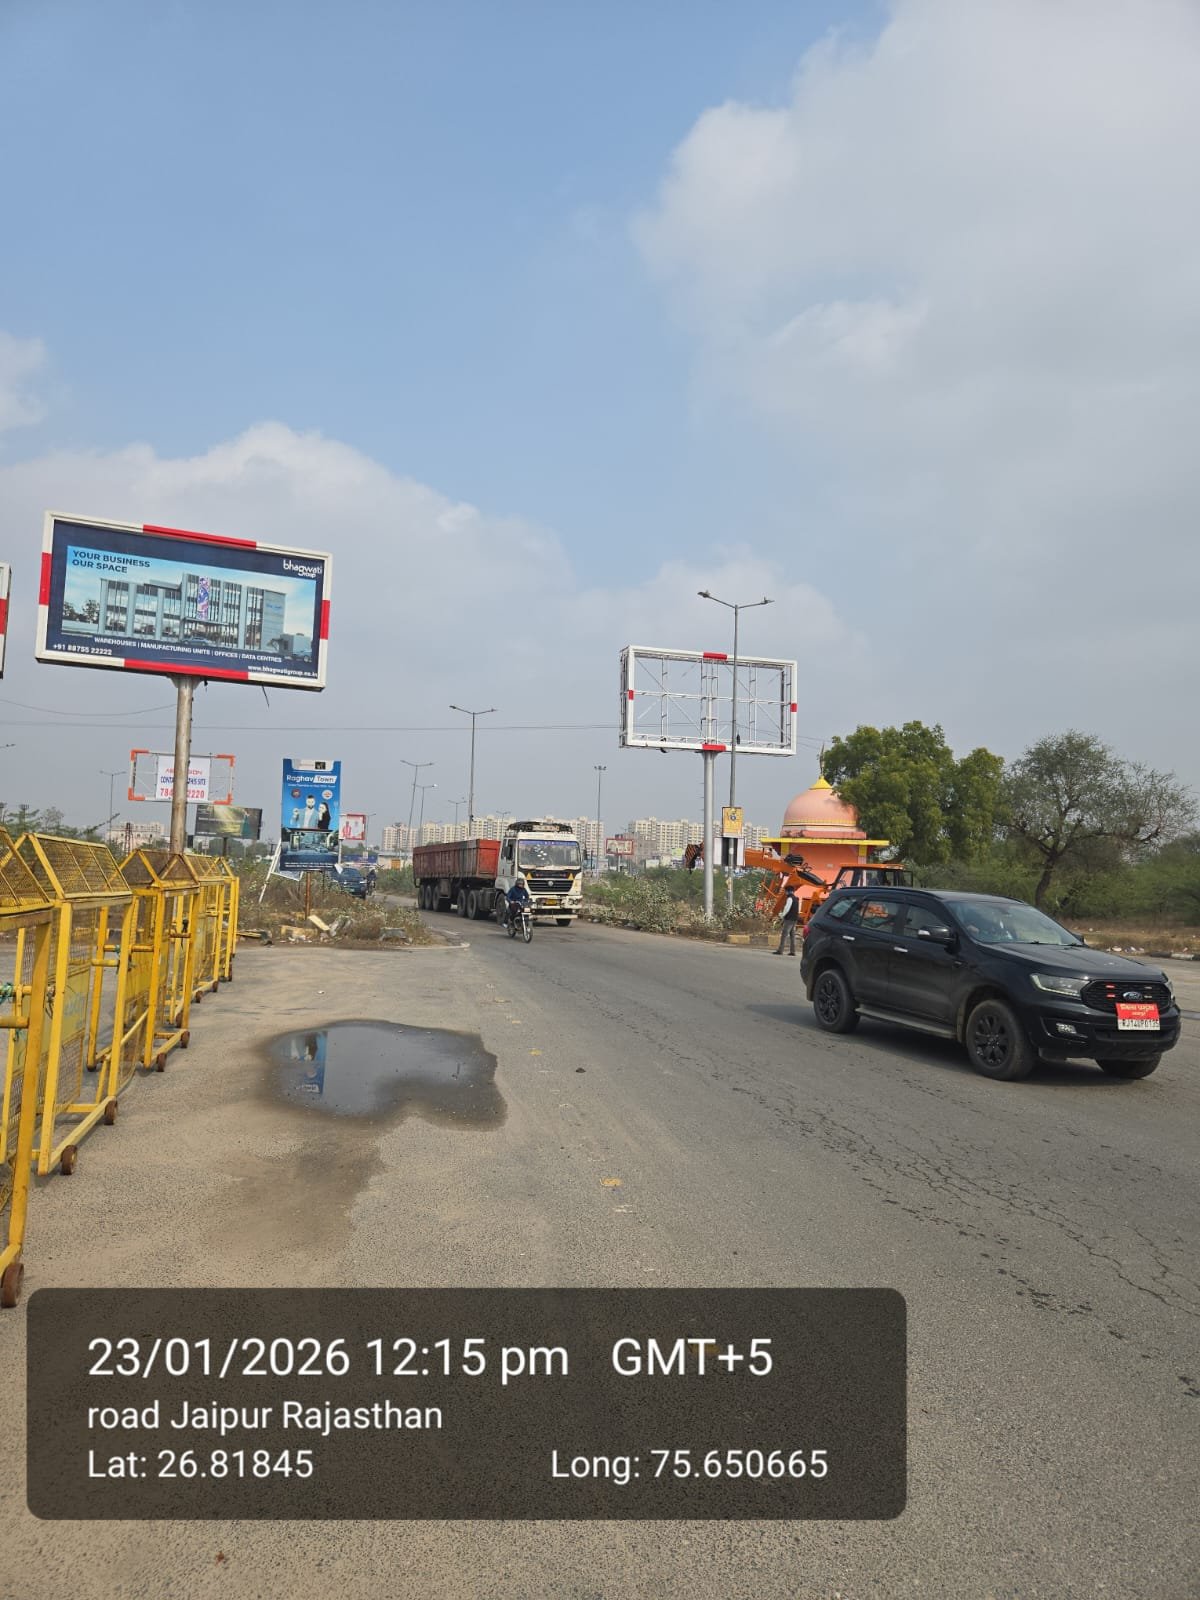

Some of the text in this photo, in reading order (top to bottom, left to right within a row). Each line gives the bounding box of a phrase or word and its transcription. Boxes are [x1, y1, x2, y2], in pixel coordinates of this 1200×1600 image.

[72, 559, 128, 573] OUR SPACE
[73, 550, 151, 568] YOUR BUSINESS
[283, 559, 323, 575] bhagwati
[94, 637, 137, 647] WAREHOUSES
[140, 642, 192, 653] MANUFACTURING
[192, 647, 211, 656] UNITS
[214, 650, 238, 659] OFFICES
[241, 653, 256, 661] DATA
[256, 654, 282, 663] CENTRES
[286, 774, 314, 783] Raghav
